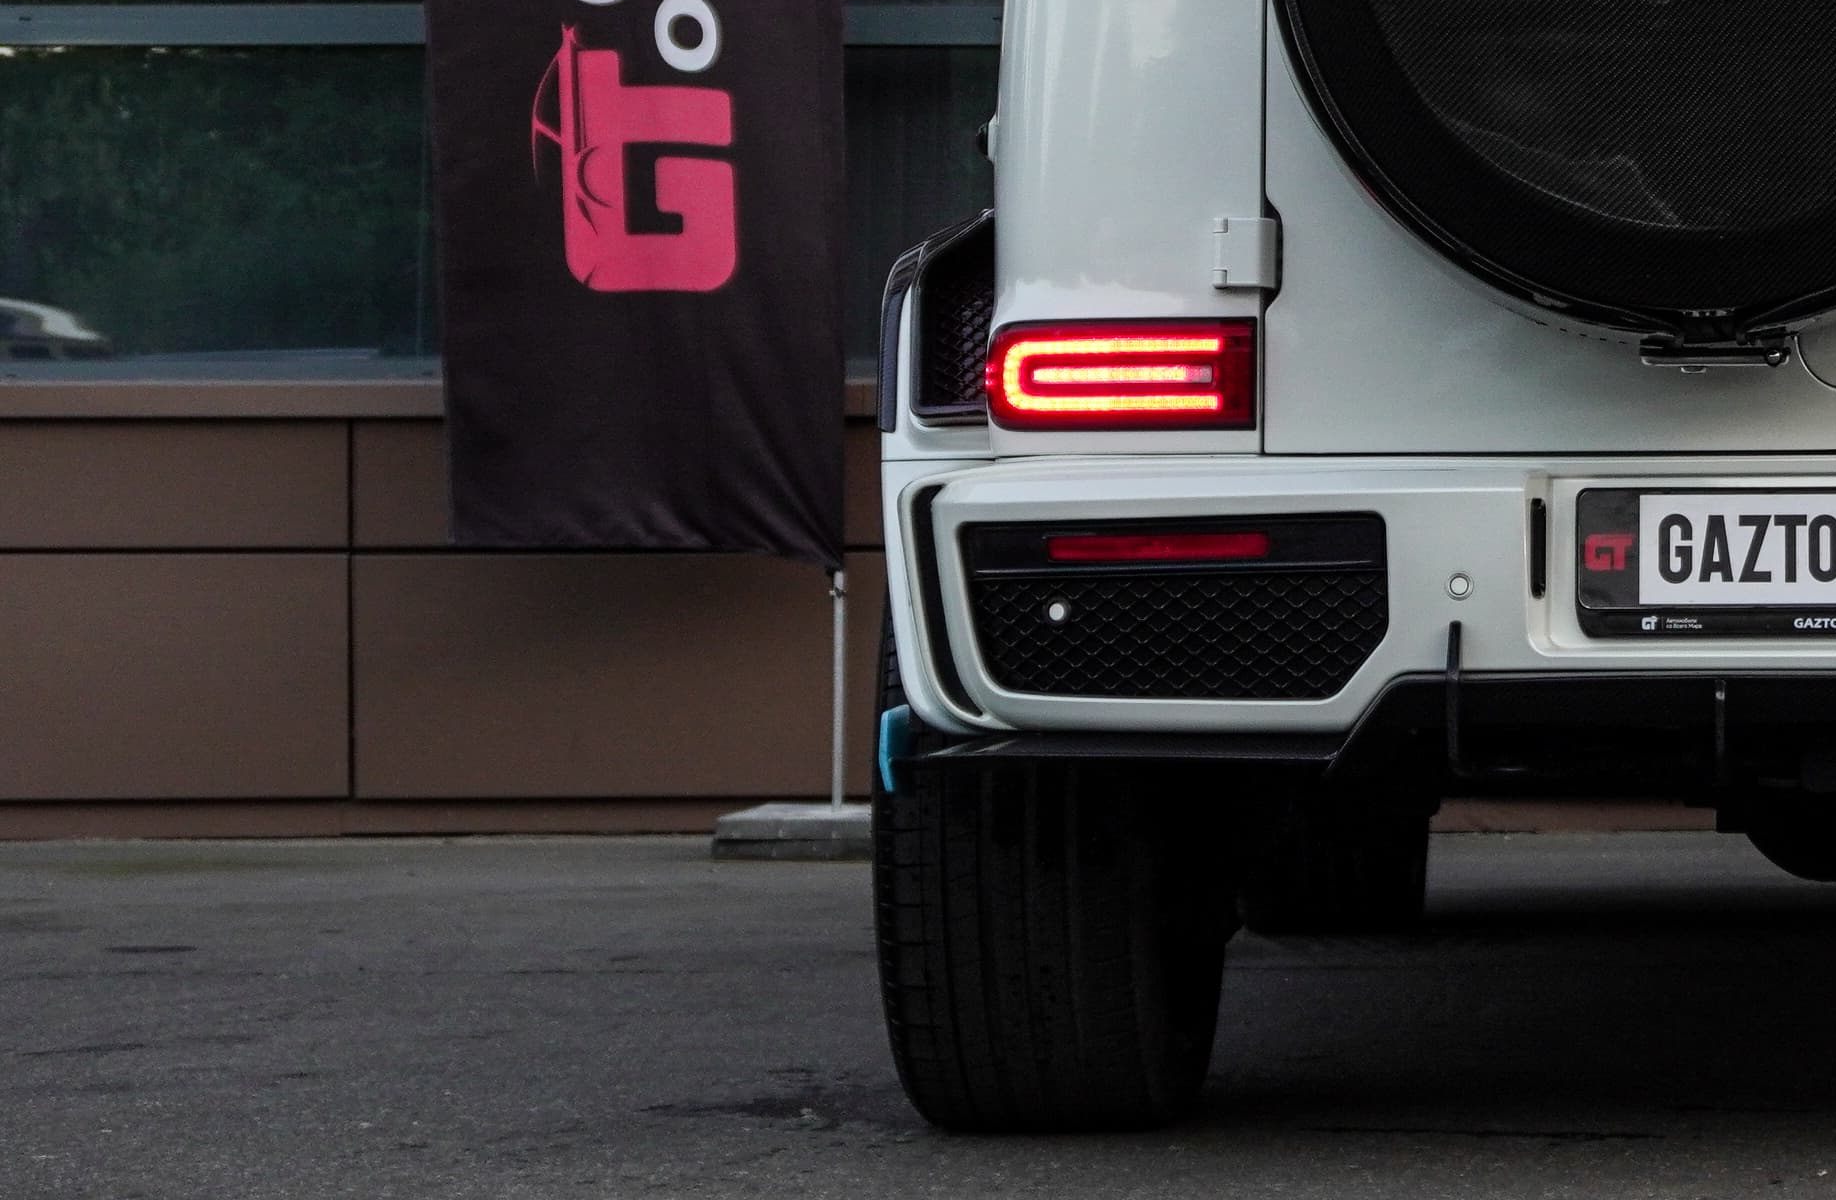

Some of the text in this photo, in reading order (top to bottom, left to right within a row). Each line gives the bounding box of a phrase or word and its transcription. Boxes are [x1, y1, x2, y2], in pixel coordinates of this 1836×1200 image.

[555, 40, 737, 292] GT
[1583, 532, 1634, 572] GT
[1641, 615, 1658, 631] GT
